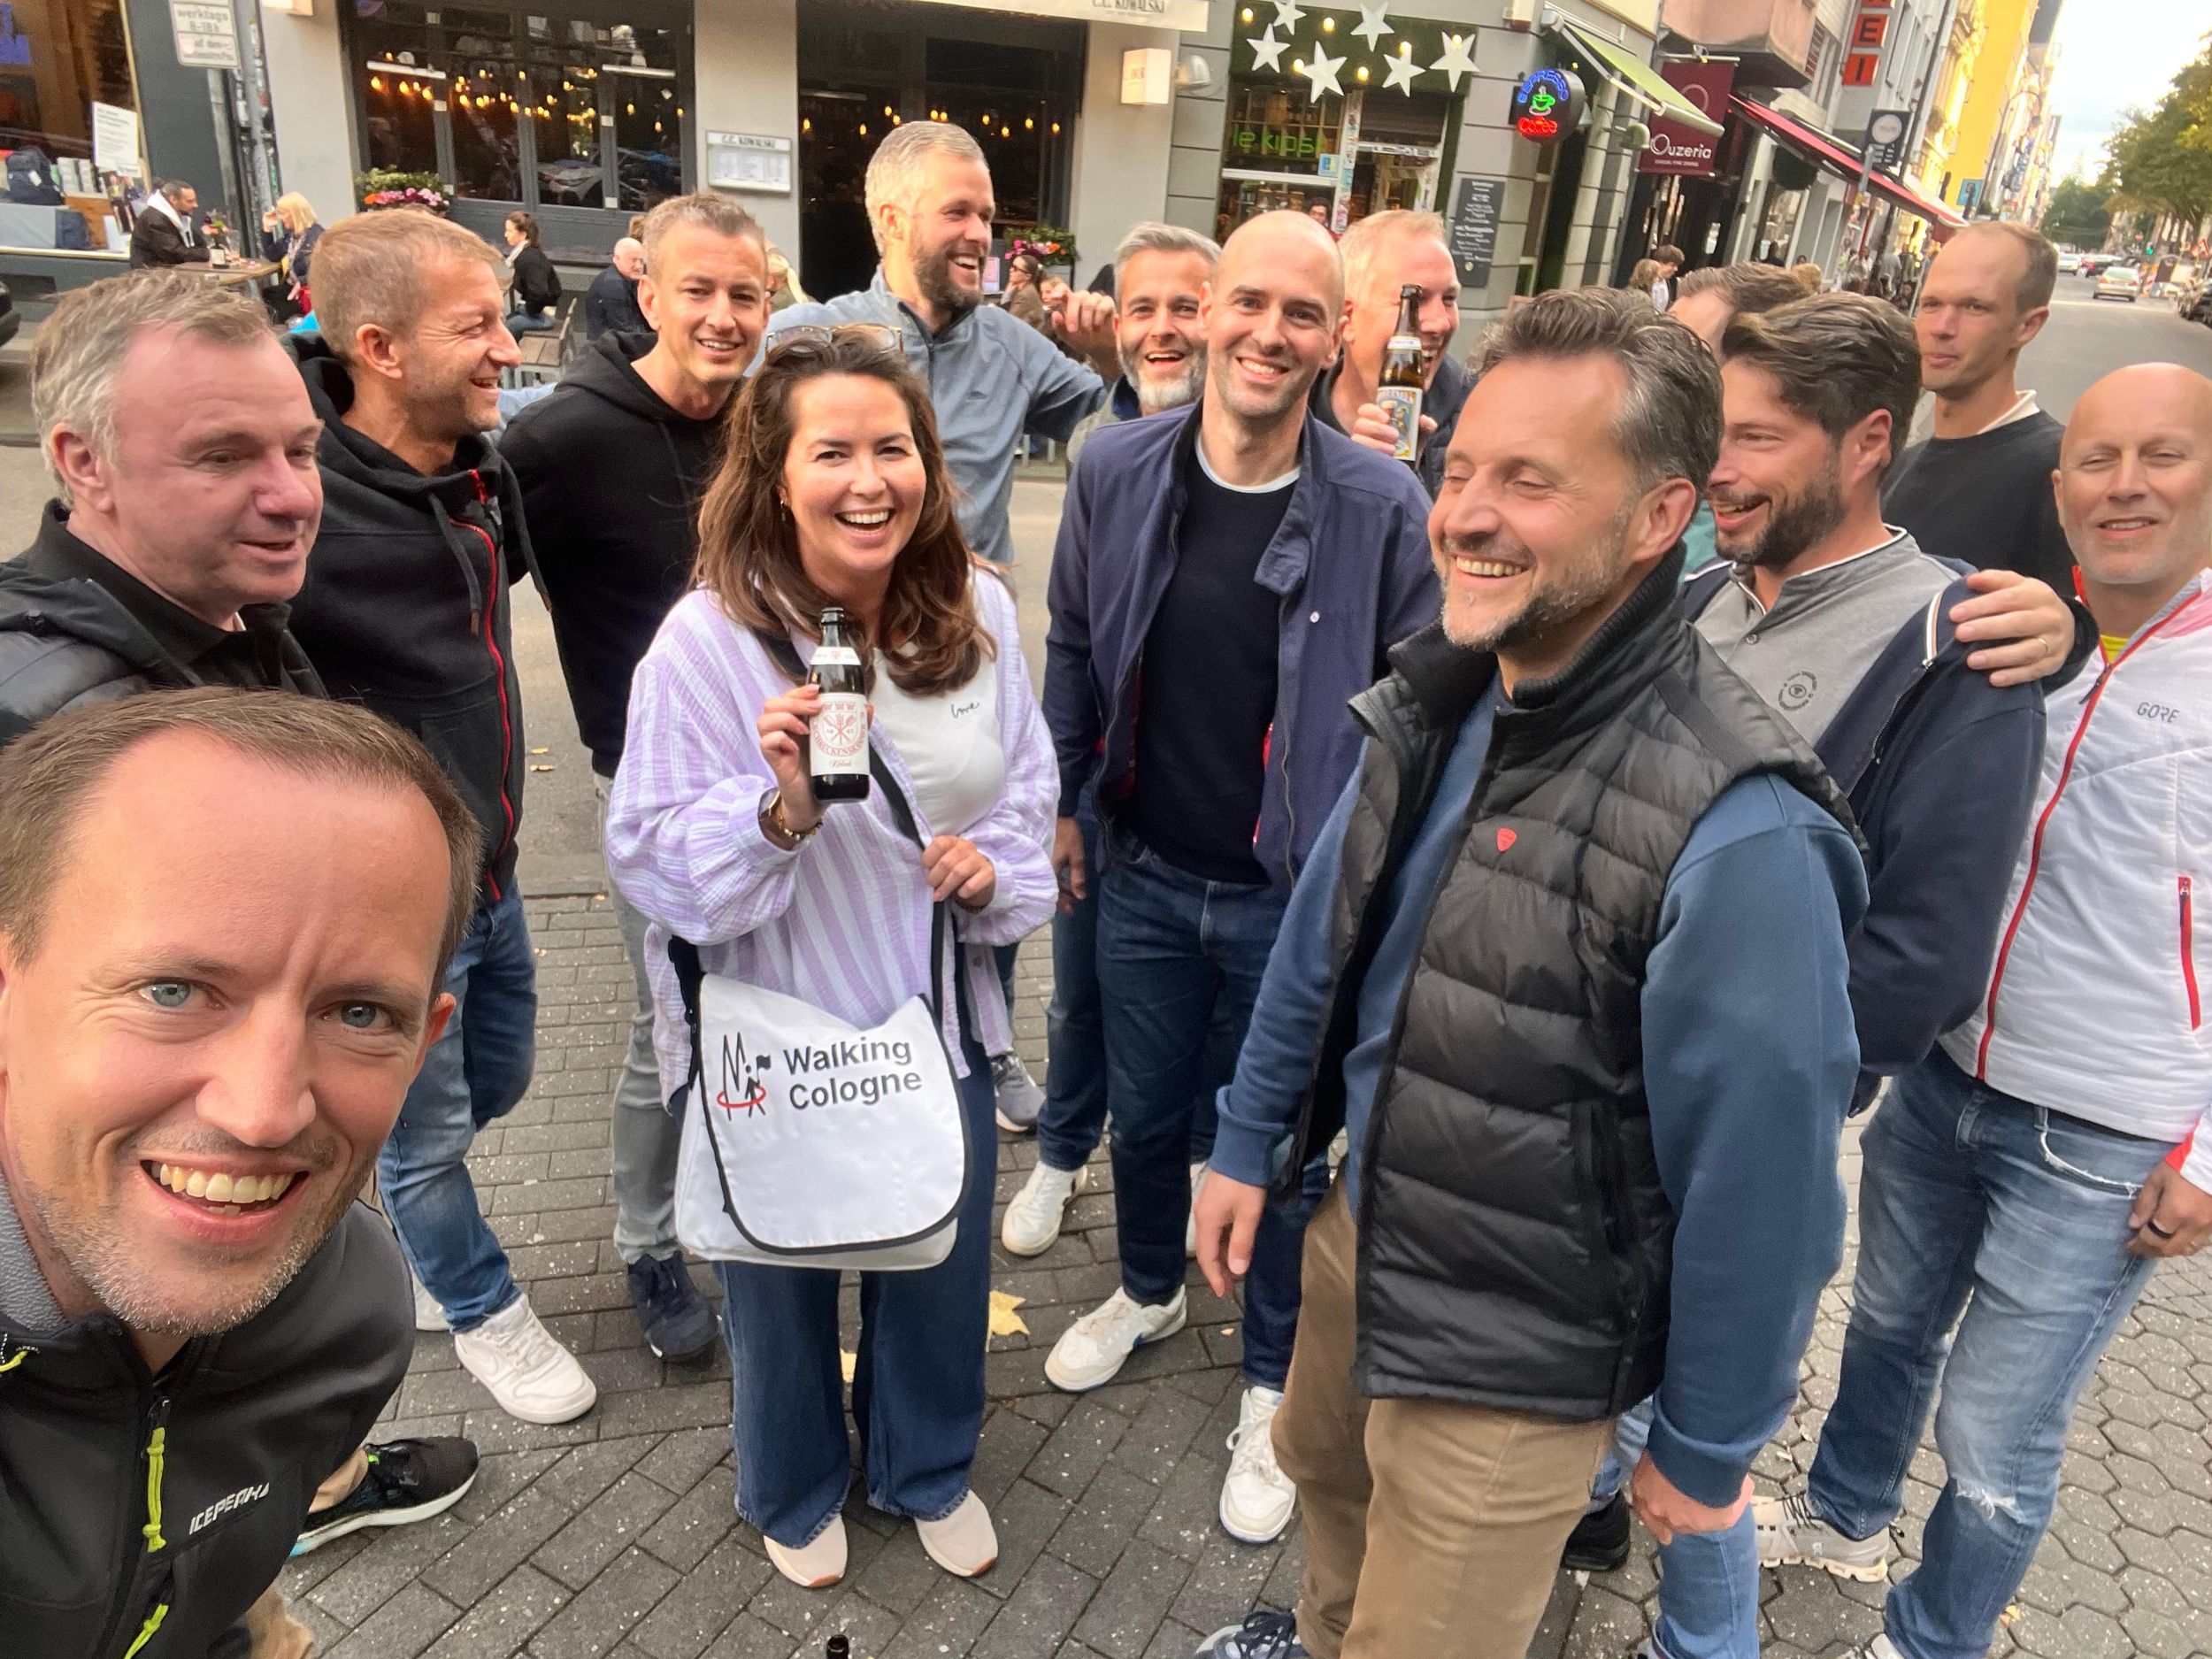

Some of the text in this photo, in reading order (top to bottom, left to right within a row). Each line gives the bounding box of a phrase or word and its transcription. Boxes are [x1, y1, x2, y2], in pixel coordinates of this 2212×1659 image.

[178, 7, 228, 23] werktags
[1517, 69, 1570, 104] ESPRESSO
[1650, 134, 1712, 158] Ouzeria
[2137, 702, 2180, 723] GORE
[783, 1036, 912, 1076] Walking
[789, 1071, 922, 1110] Cologne
[188, 1482, 270, 1535] ICEPEAK
